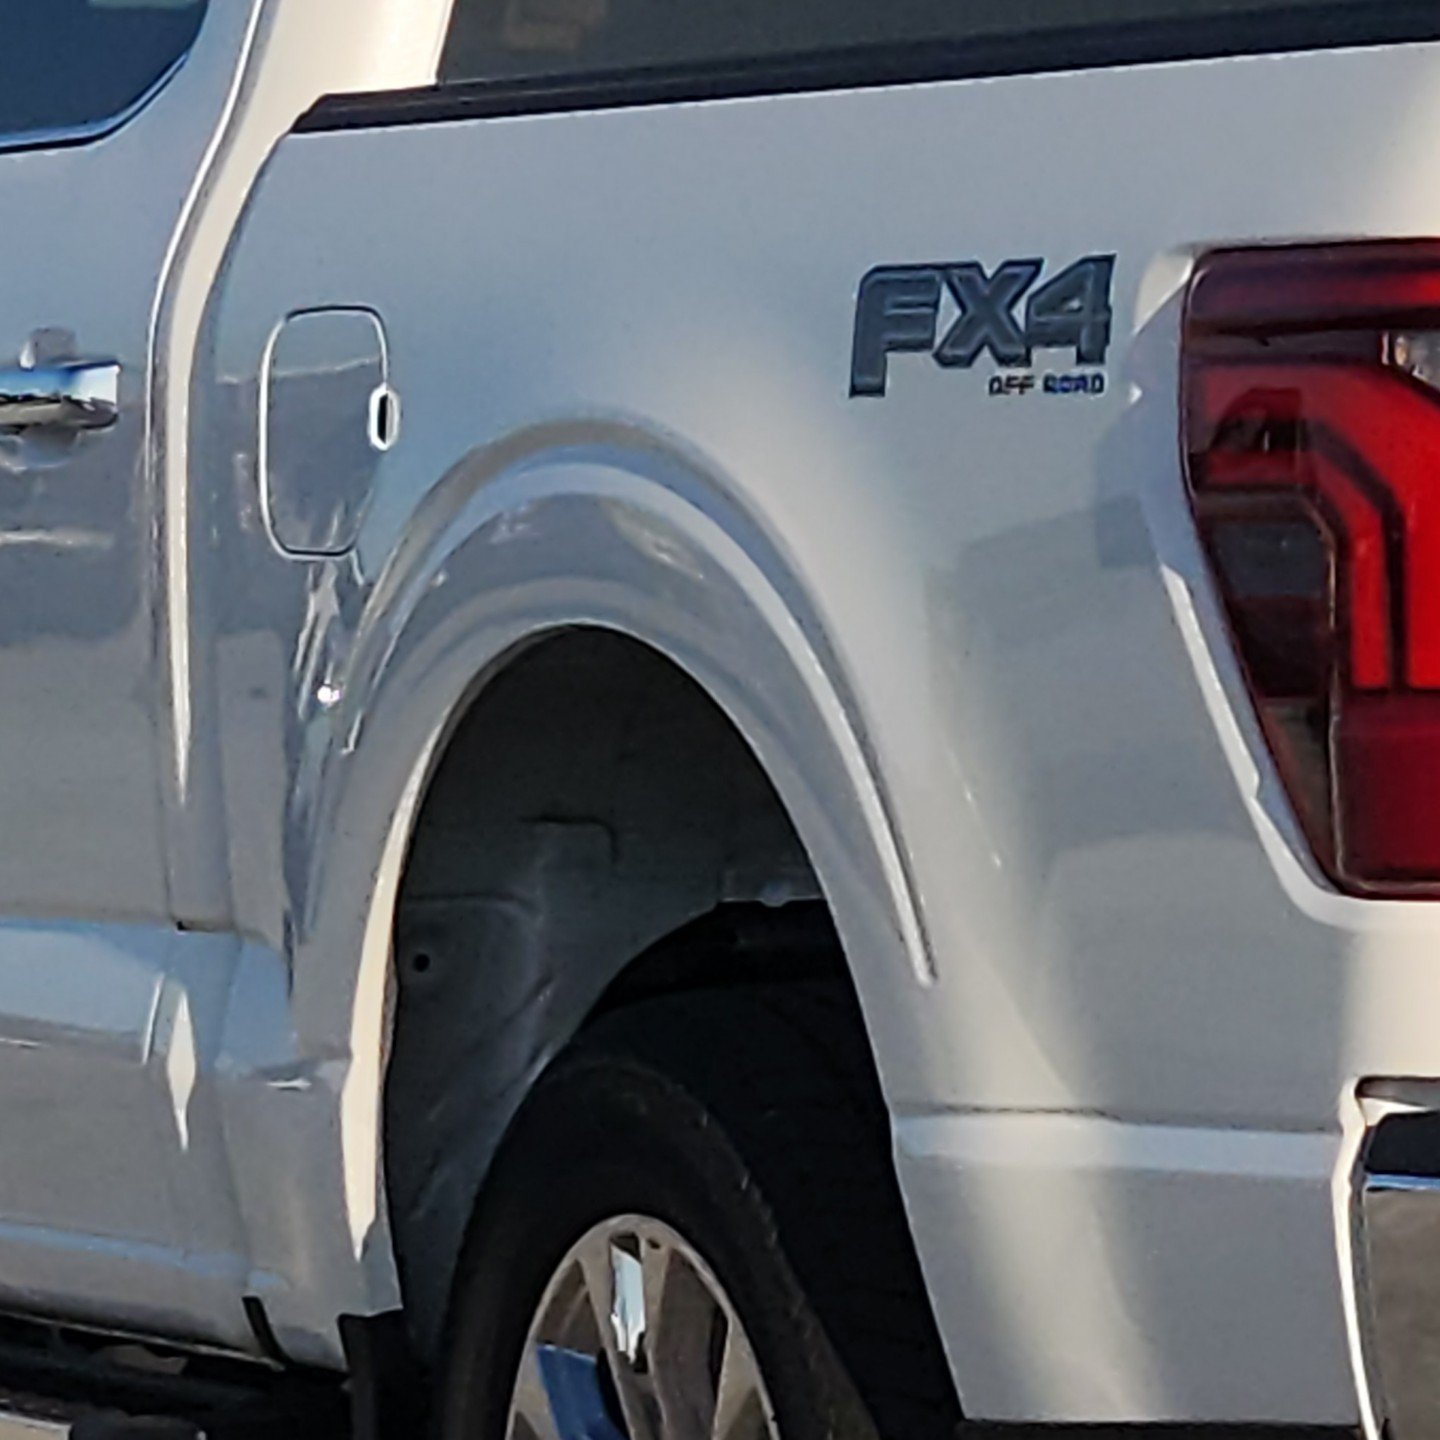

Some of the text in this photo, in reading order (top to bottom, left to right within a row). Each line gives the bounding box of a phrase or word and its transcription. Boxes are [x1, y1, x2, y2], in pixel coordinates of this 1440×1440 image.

[849, 254, 1117, 398] FX4
[989, 373, 1105, 396] OFF ROAD
